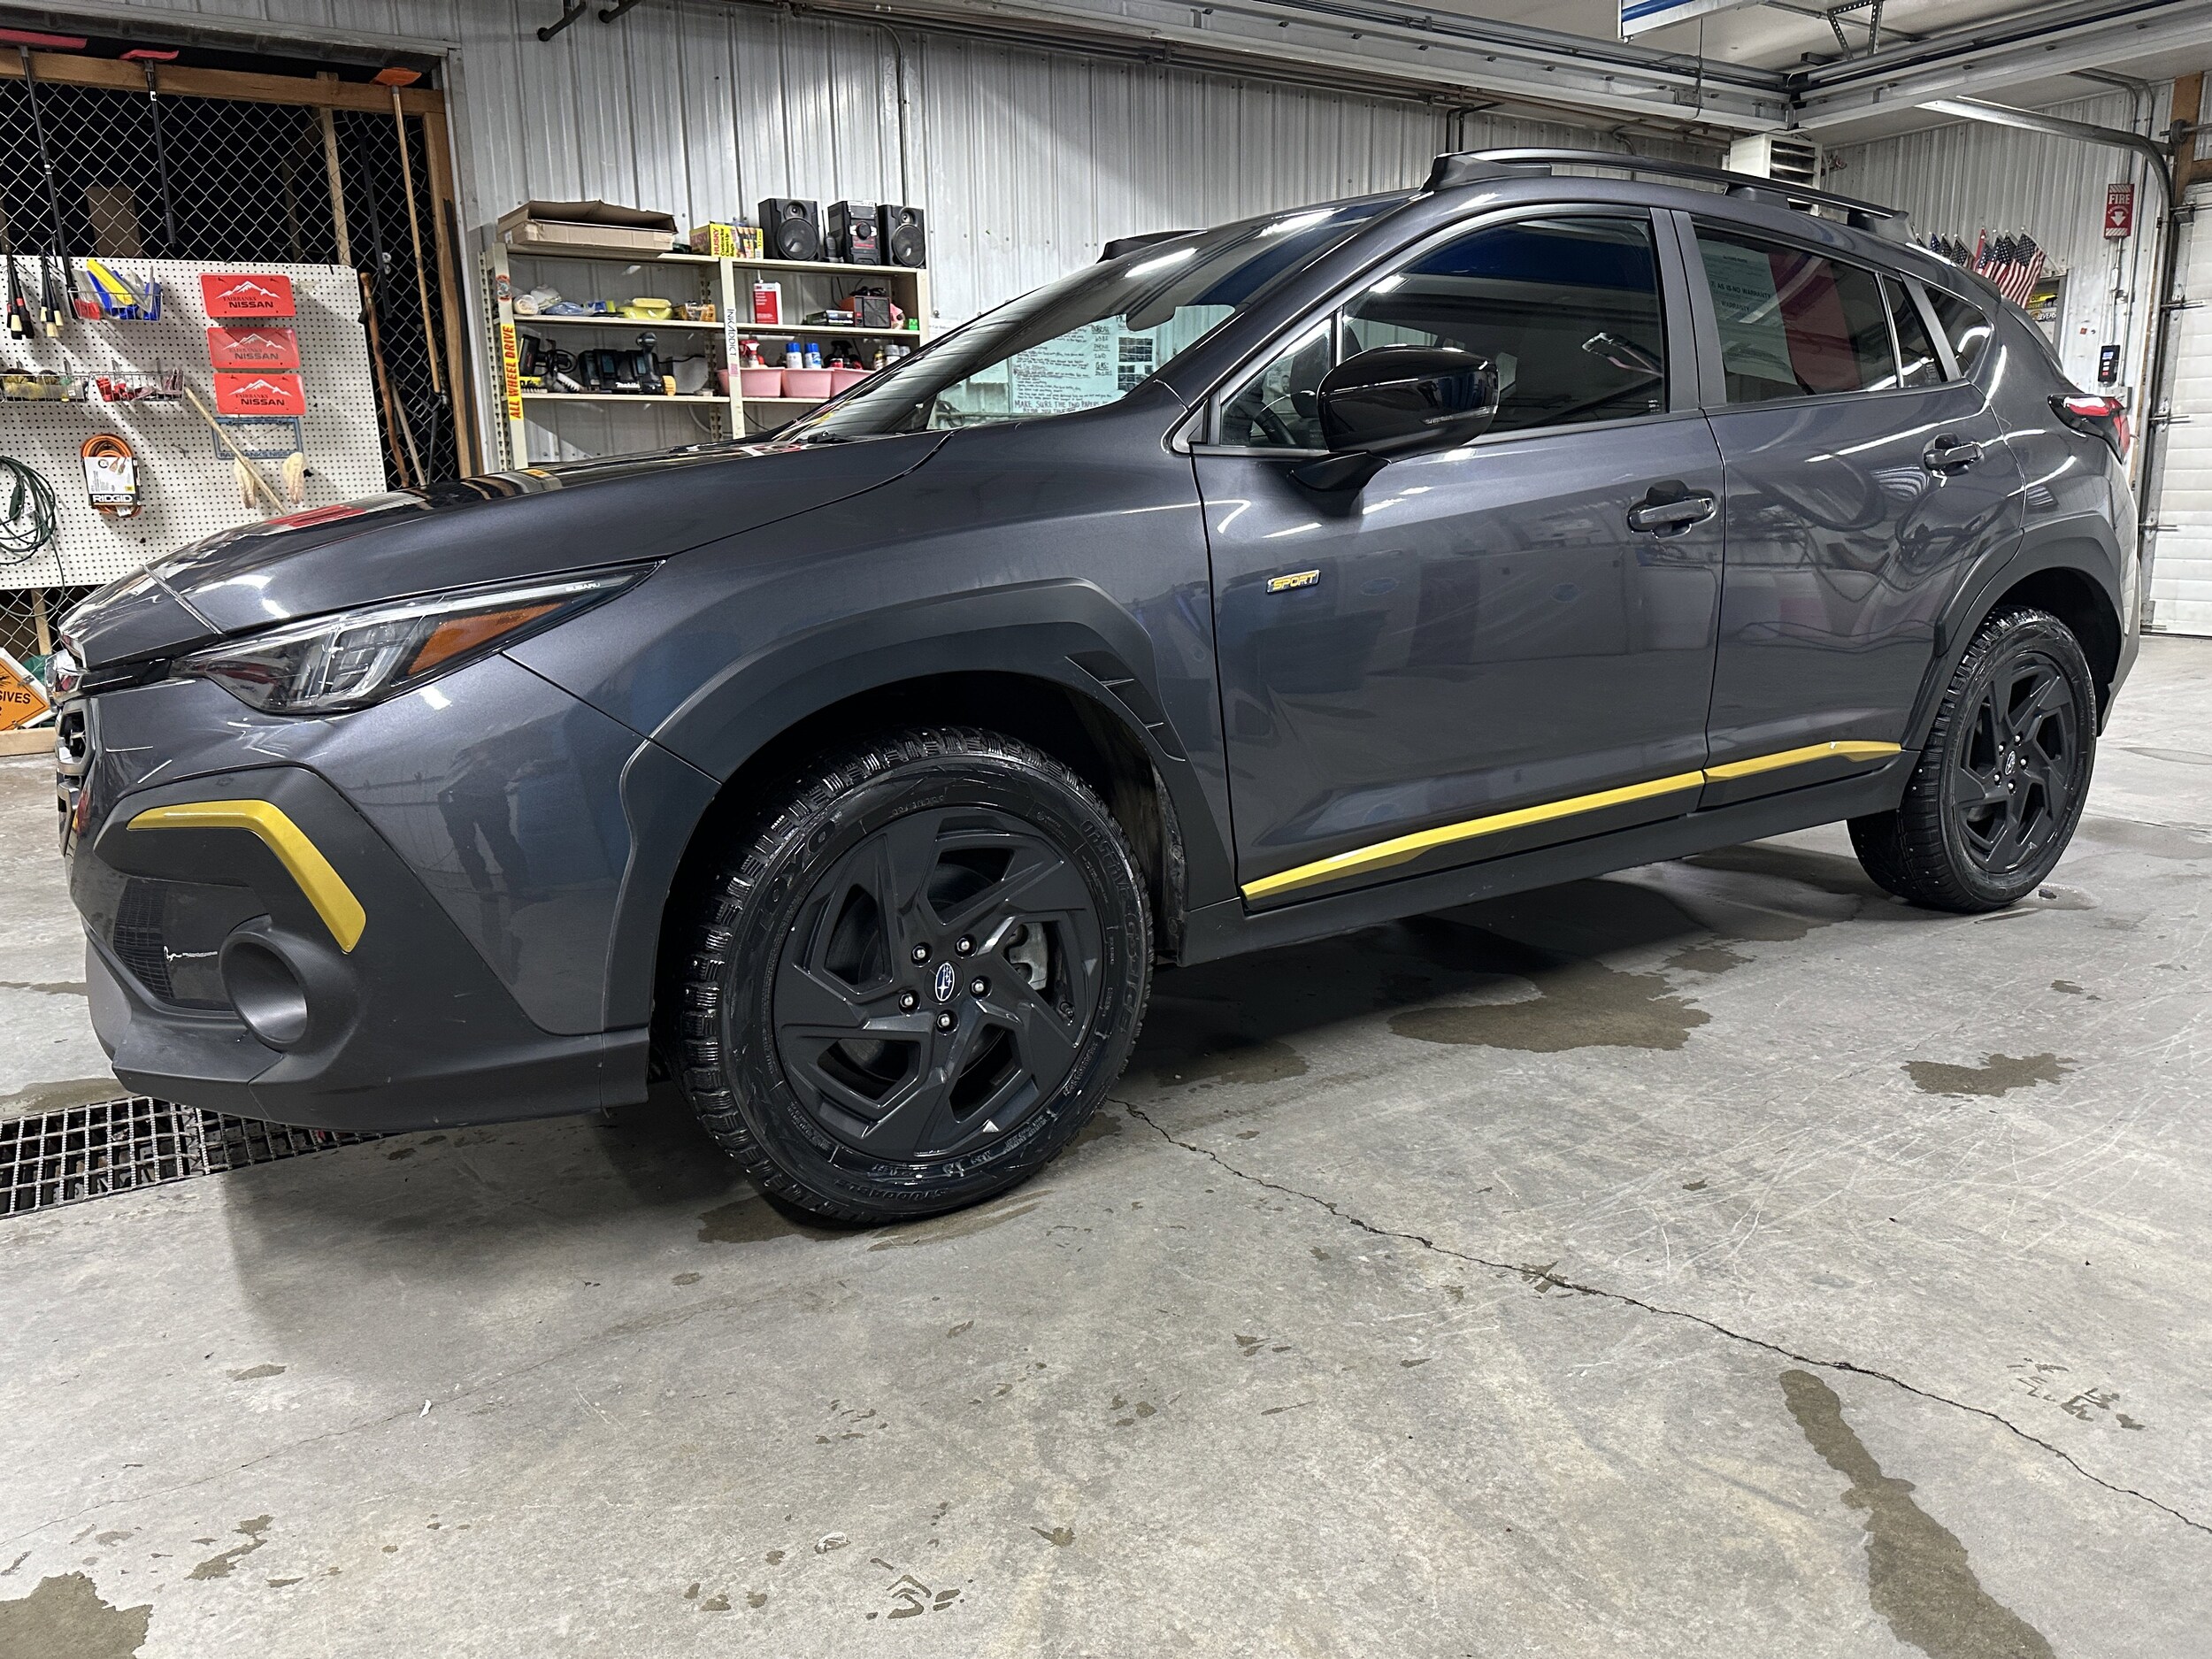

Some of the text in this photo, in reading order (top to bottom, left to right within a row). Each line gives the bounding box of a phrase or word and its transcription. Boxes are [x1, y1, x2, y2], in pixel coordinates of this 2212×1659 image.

[2108, 194, 2131, 204] FIRE
[1742, 288, 1771, 299] WARRANTY
[502, 326, 521, 419] ALL WHEEL DRIVE
[1014, 400, 1033, 409] MAKE
[1035, 400, 1052, 409] SURE
[92, 494, 134, 503] RIDGID
[1272, 572, 1317, 592] SPORT
[0, 690, 31, 704] IVES
